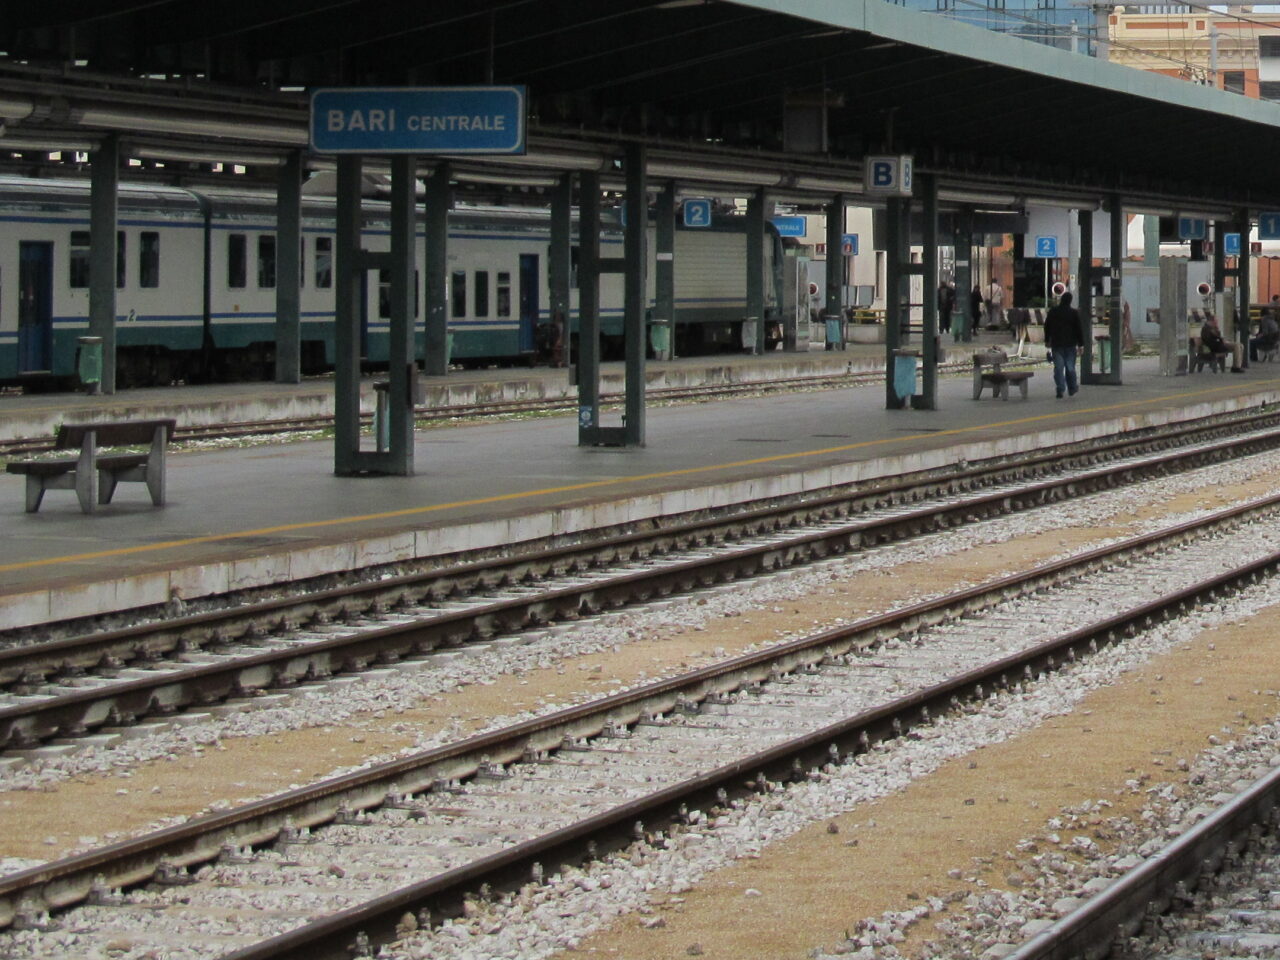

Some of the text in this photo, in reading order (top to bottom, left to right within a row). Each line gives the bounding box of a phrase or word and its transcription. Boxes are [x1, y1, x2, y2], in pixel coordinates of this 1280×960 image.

[327, 109, 505, 132] BARI CENTRALE
[873, 162, 893, 186] B
[691, 205, 704, 221] 2
[1188, 219, 1196, 233] 1
[1268, 217, 1275, 234] 1
[1042, 239, 1051, 250] 2
[1232, 237, 1239, 247] 1
[128, 309, 136, 322] 2
